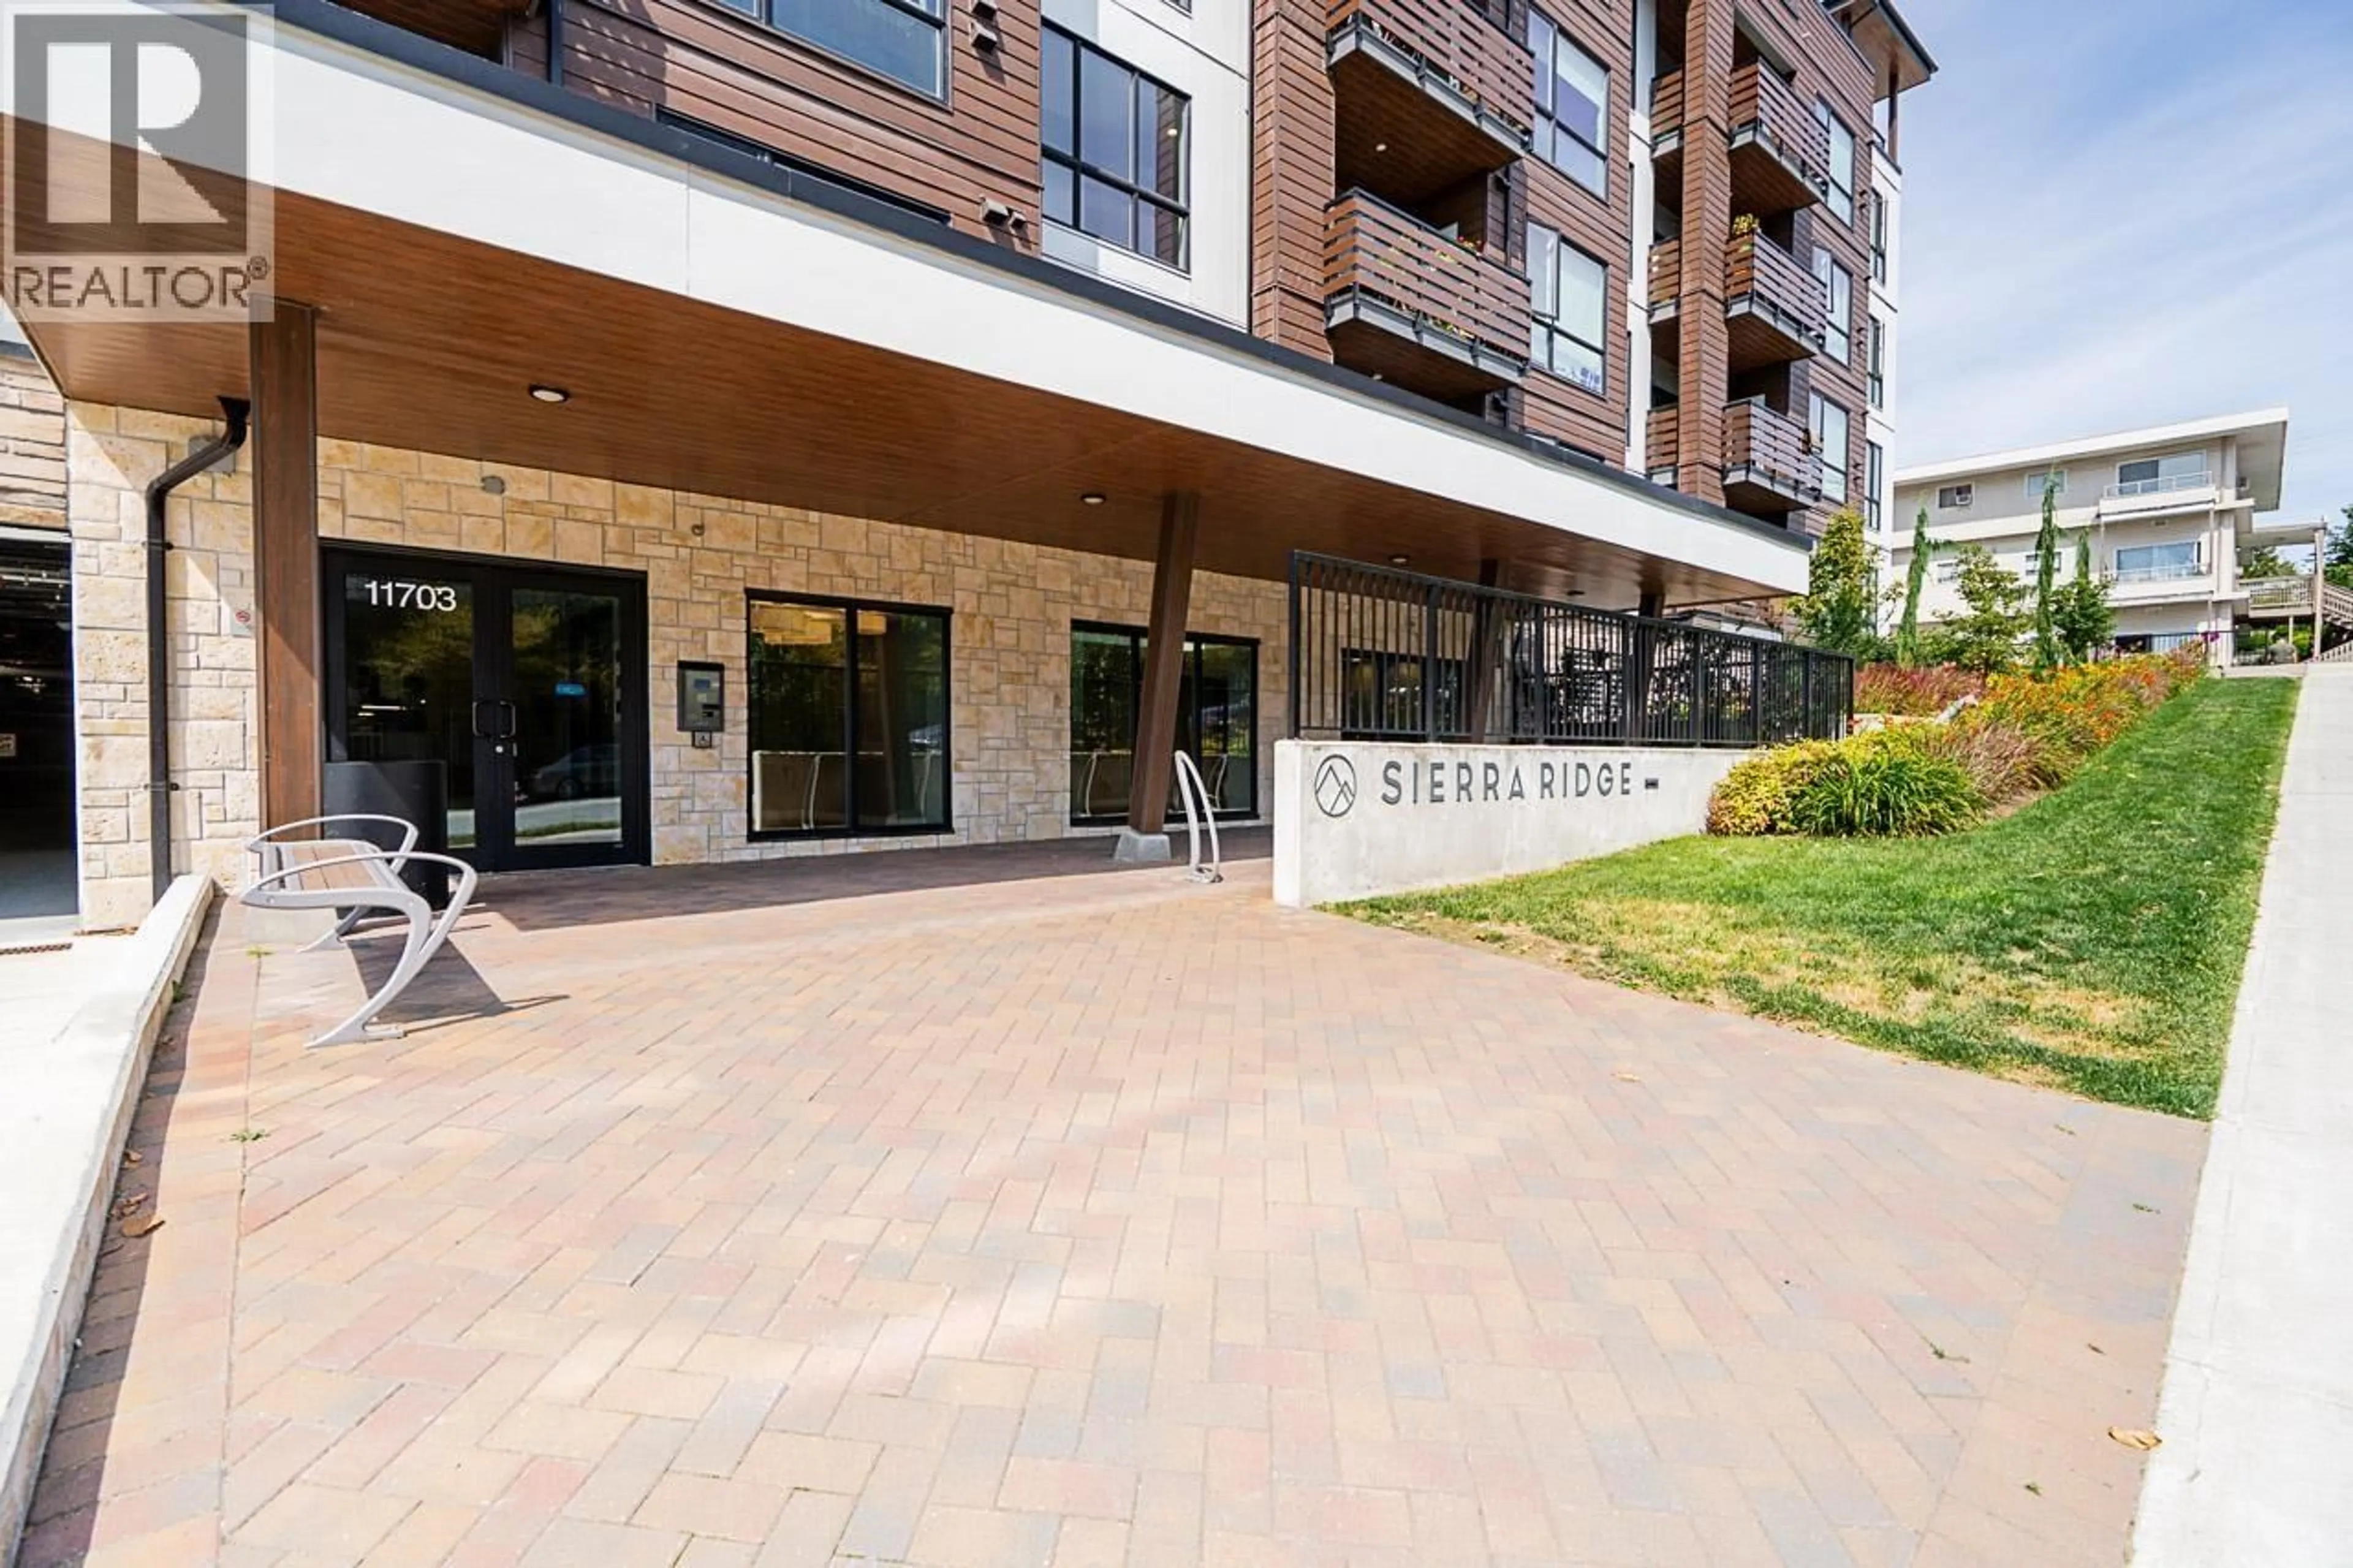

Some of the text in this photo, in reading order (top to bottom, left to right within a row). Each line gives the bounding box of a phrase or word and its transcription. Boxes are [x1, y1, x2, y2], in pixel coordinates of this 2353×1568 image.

[364, 580, 457, 612] 11703
[1381, 760, 1631, 806] SIERRA RIDGE
